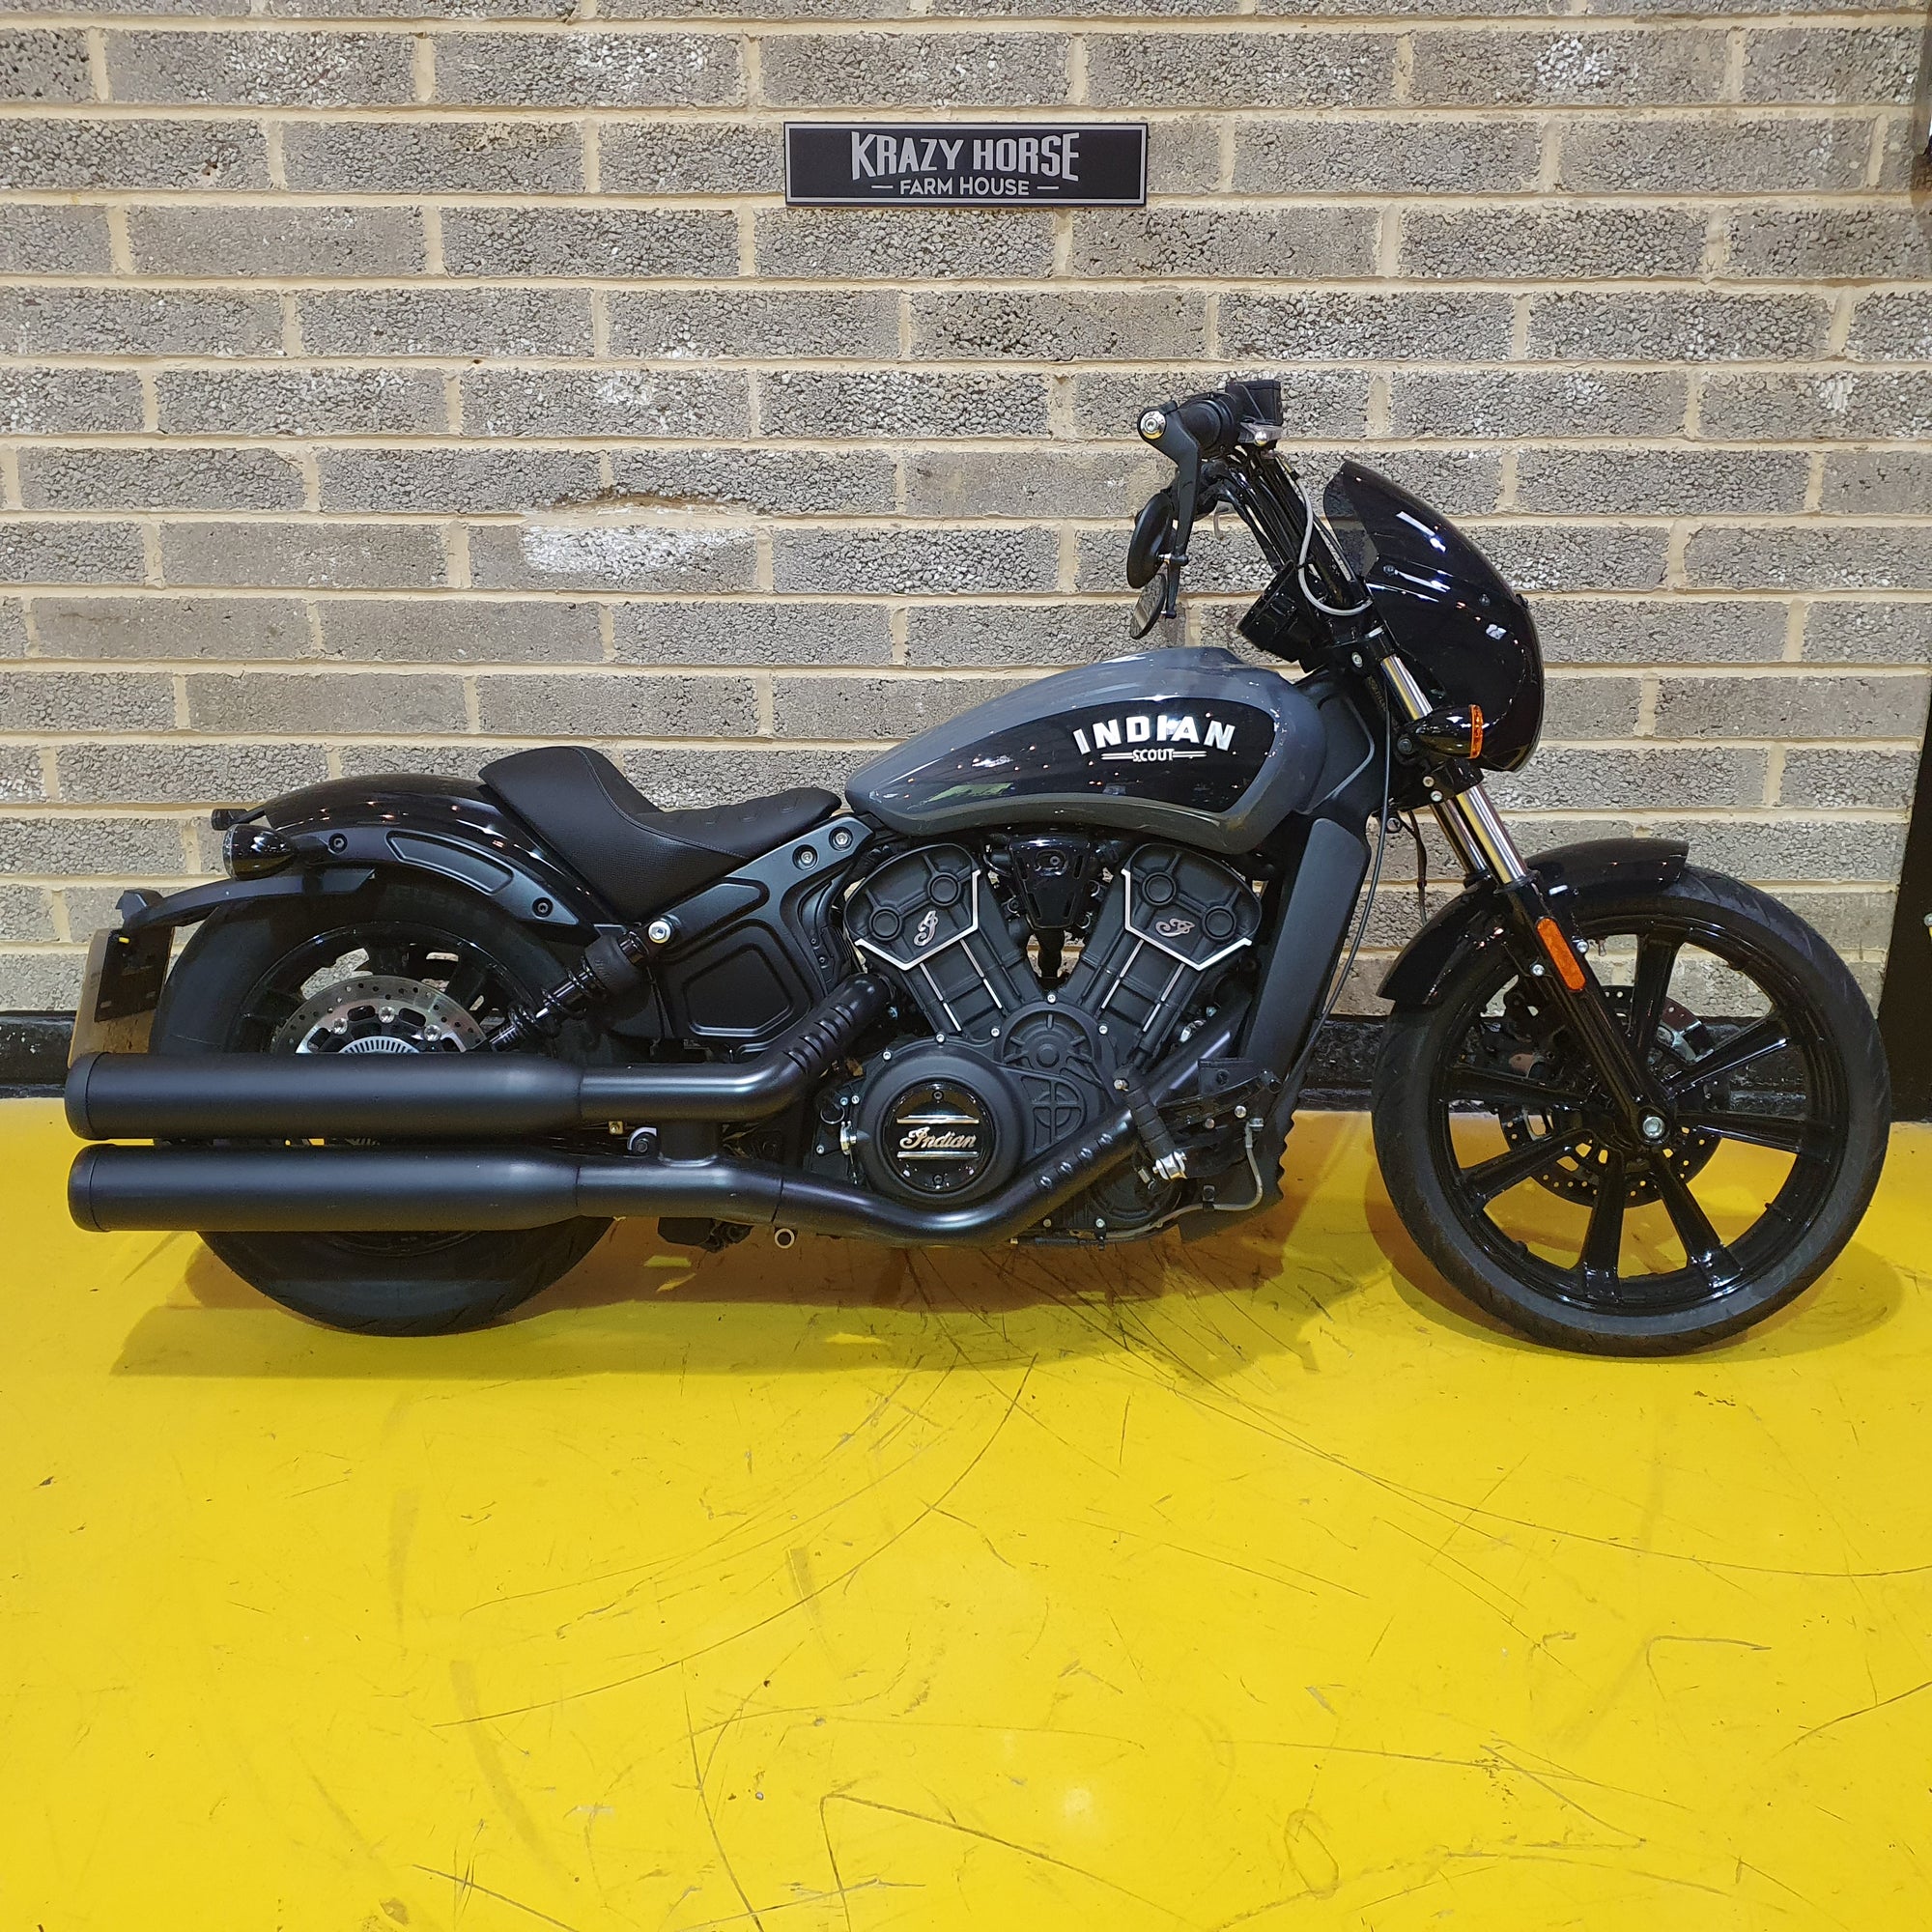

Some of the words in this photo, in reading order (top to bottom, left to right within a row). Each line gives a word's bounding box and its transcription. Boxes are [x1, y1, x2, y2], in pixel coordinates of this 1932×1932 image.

[851, 131, 964, 181] KRAZY
[973, 131, 1080, 182] HORSE
[899, 179, 953, 195] FARM
[960, 177, 1030, 196] HOUSE
[1072, 715, 1236, 755] INDIAN
[1132, 748, 1176, 763] SCOUT
[899, 1125, 977, 1150] Indian
